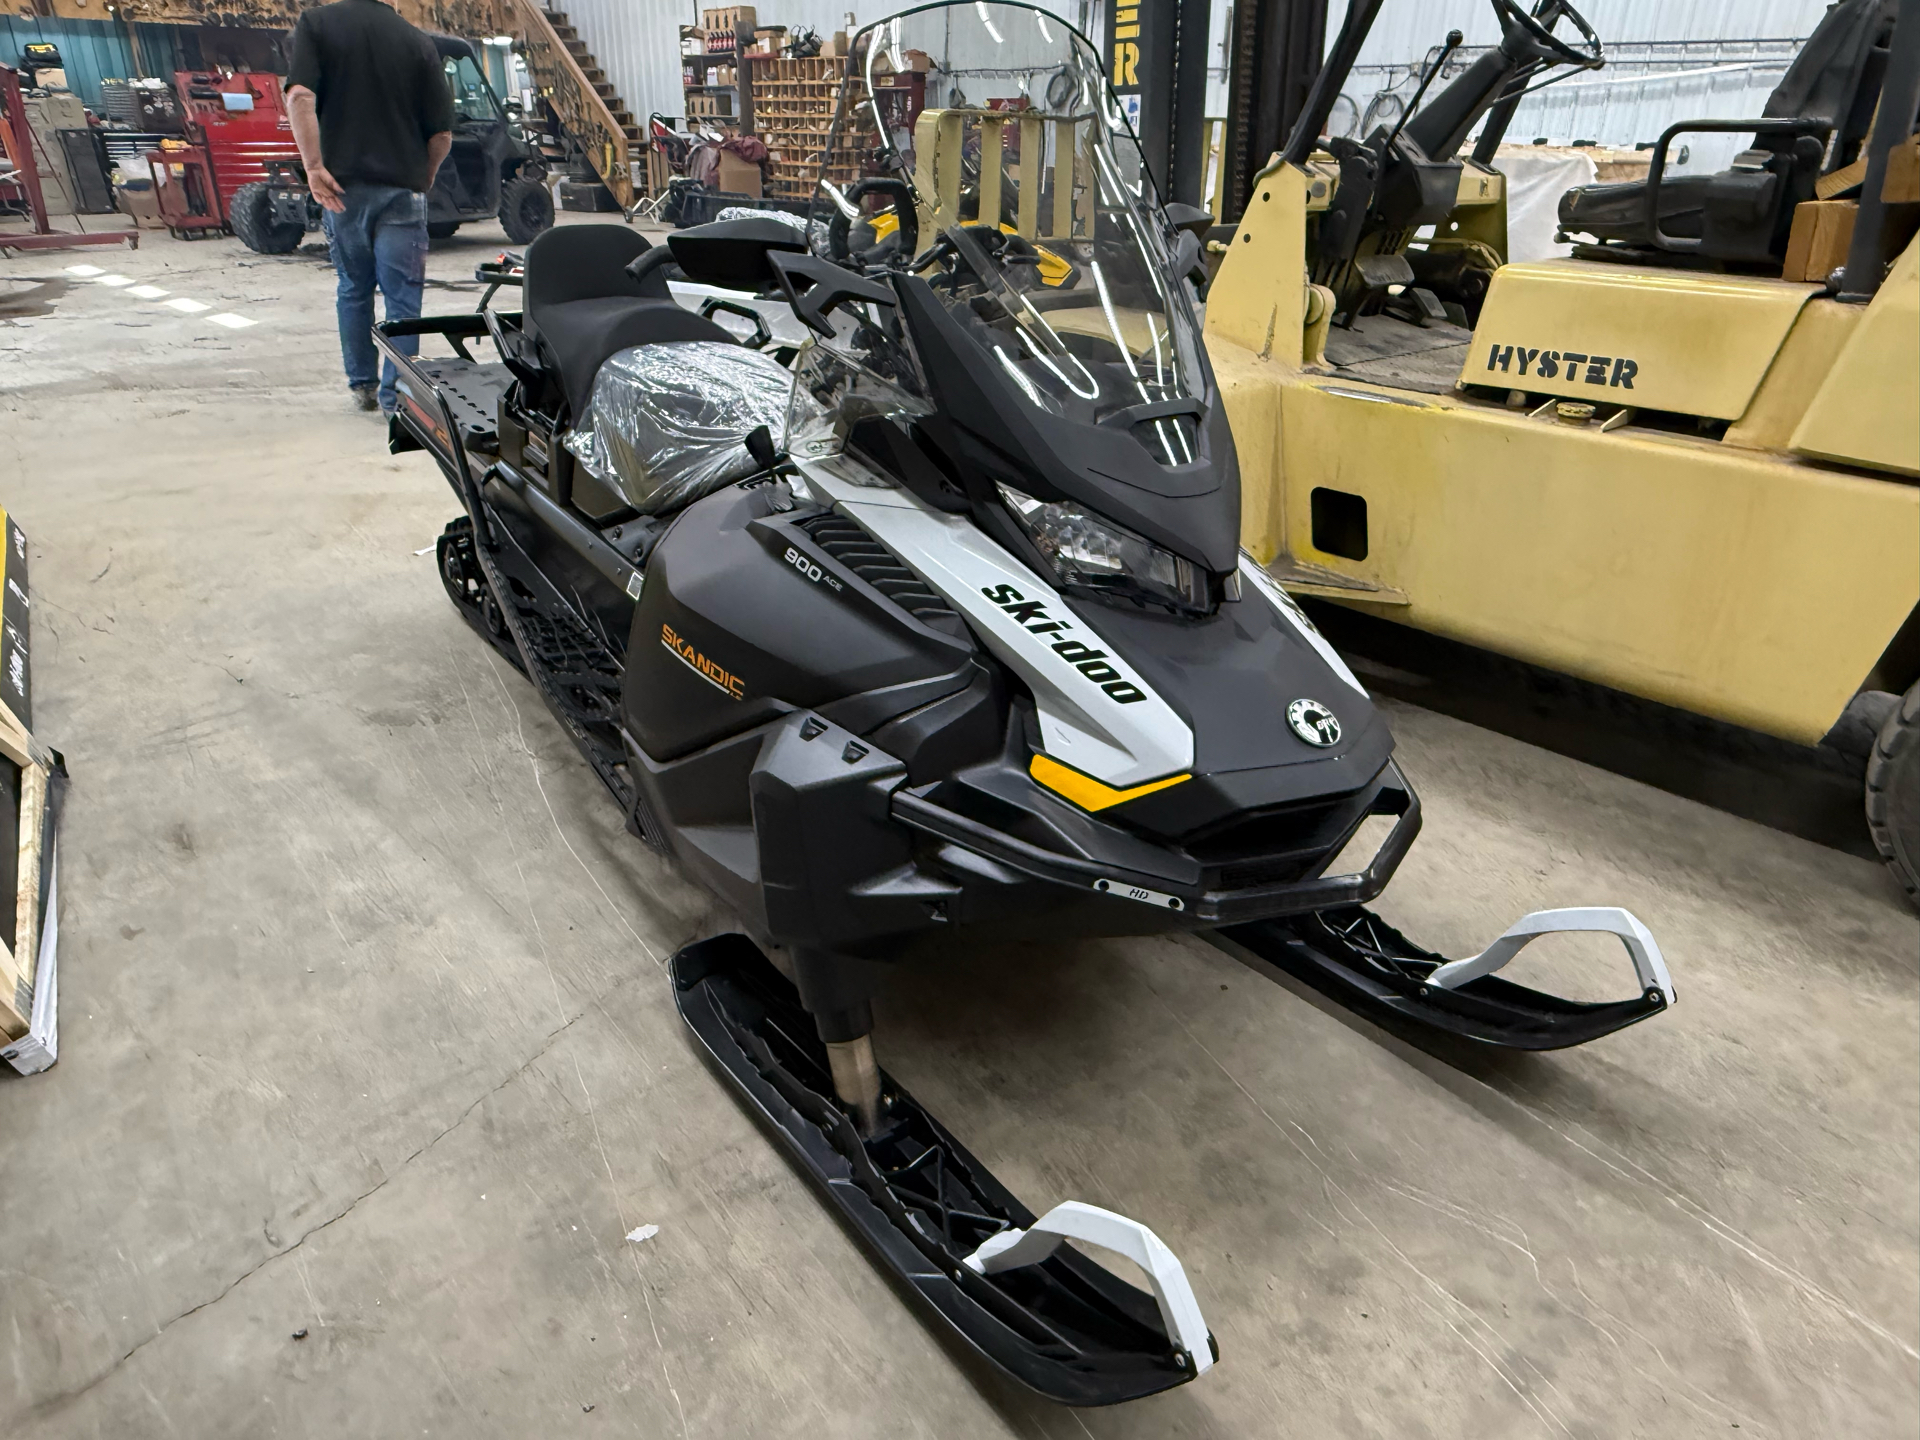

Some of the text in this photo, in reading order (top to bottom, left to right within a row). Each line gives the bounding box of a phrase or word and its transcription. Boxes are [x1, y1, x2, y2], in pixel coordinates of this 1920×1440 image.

[1487, 343, 1639, 390] HYSTER
[784, 547, 844, 592] 900 ACE
[662, 623, 745, 696] SKANDIC
[981, 583, 1148, 705] ski-doo
[1129, 888, 1150, 900] HD
